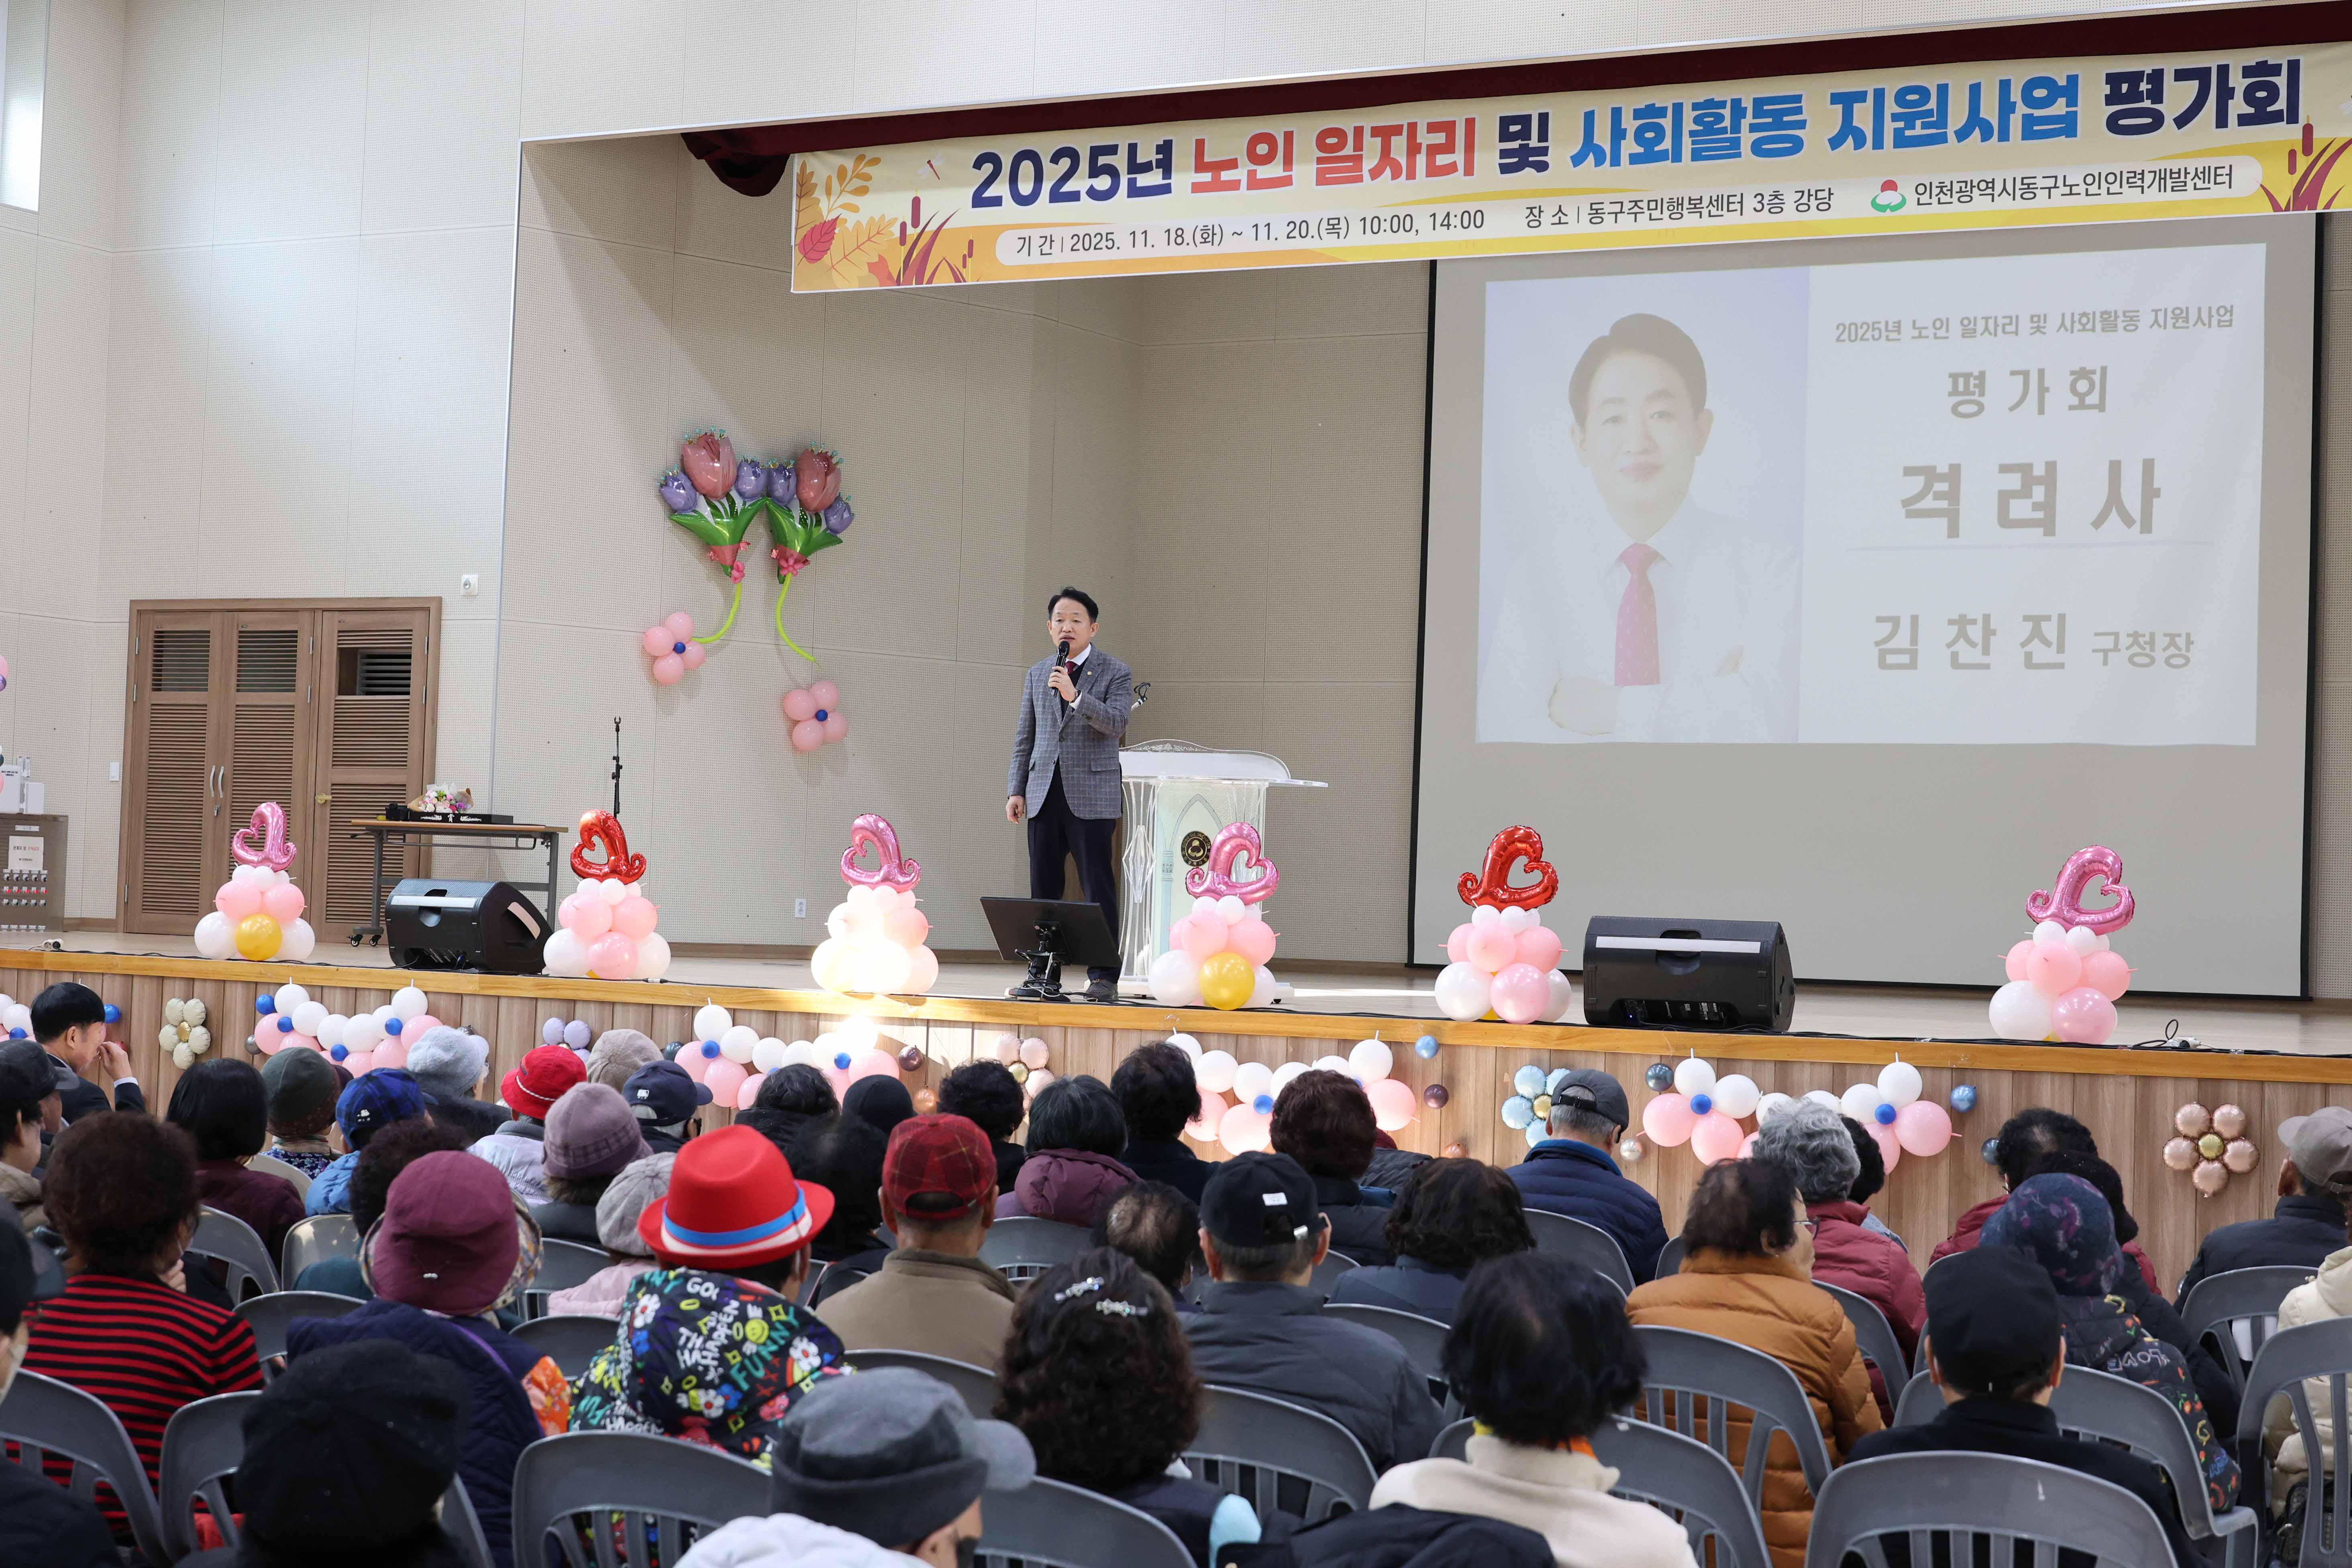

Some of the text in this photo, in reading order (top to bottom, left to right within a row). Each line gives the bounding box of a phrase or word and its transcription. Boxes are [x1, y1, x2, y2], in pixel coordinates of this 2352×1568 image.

[972, 59, 2301, 208] 2025년 노인 일자리 및 사회활동 지원사업 평가회
[1587, 193, 1744, 225] 동구주민행복센터
[1753, 190, 1786, 214] 3층
[1794, 187, 1834, 212] 강당
[1914, 165, 2233, 206] 인천광역시동구노인인력개발센터
[1070, 232, 1120, 251] 2025.
[1129, 229, 1155, 249] 11.
[1164, 224, 1223, 248] 18.(화)
[1252, 222, 1279, 241] 11.
[1286, 216, 1350, 240] 20.(목)
[1359, 213, 1419, 236] 10:00,
[1429, 209, 1485, 231] 14:00
[1835, 304, 2234, 342] 2025년 노인 일자리 및 사회활동 지원사업
[2091, 630, 2194, 669] 구청장
[729, 1306, 800, 1391] FUNNY
